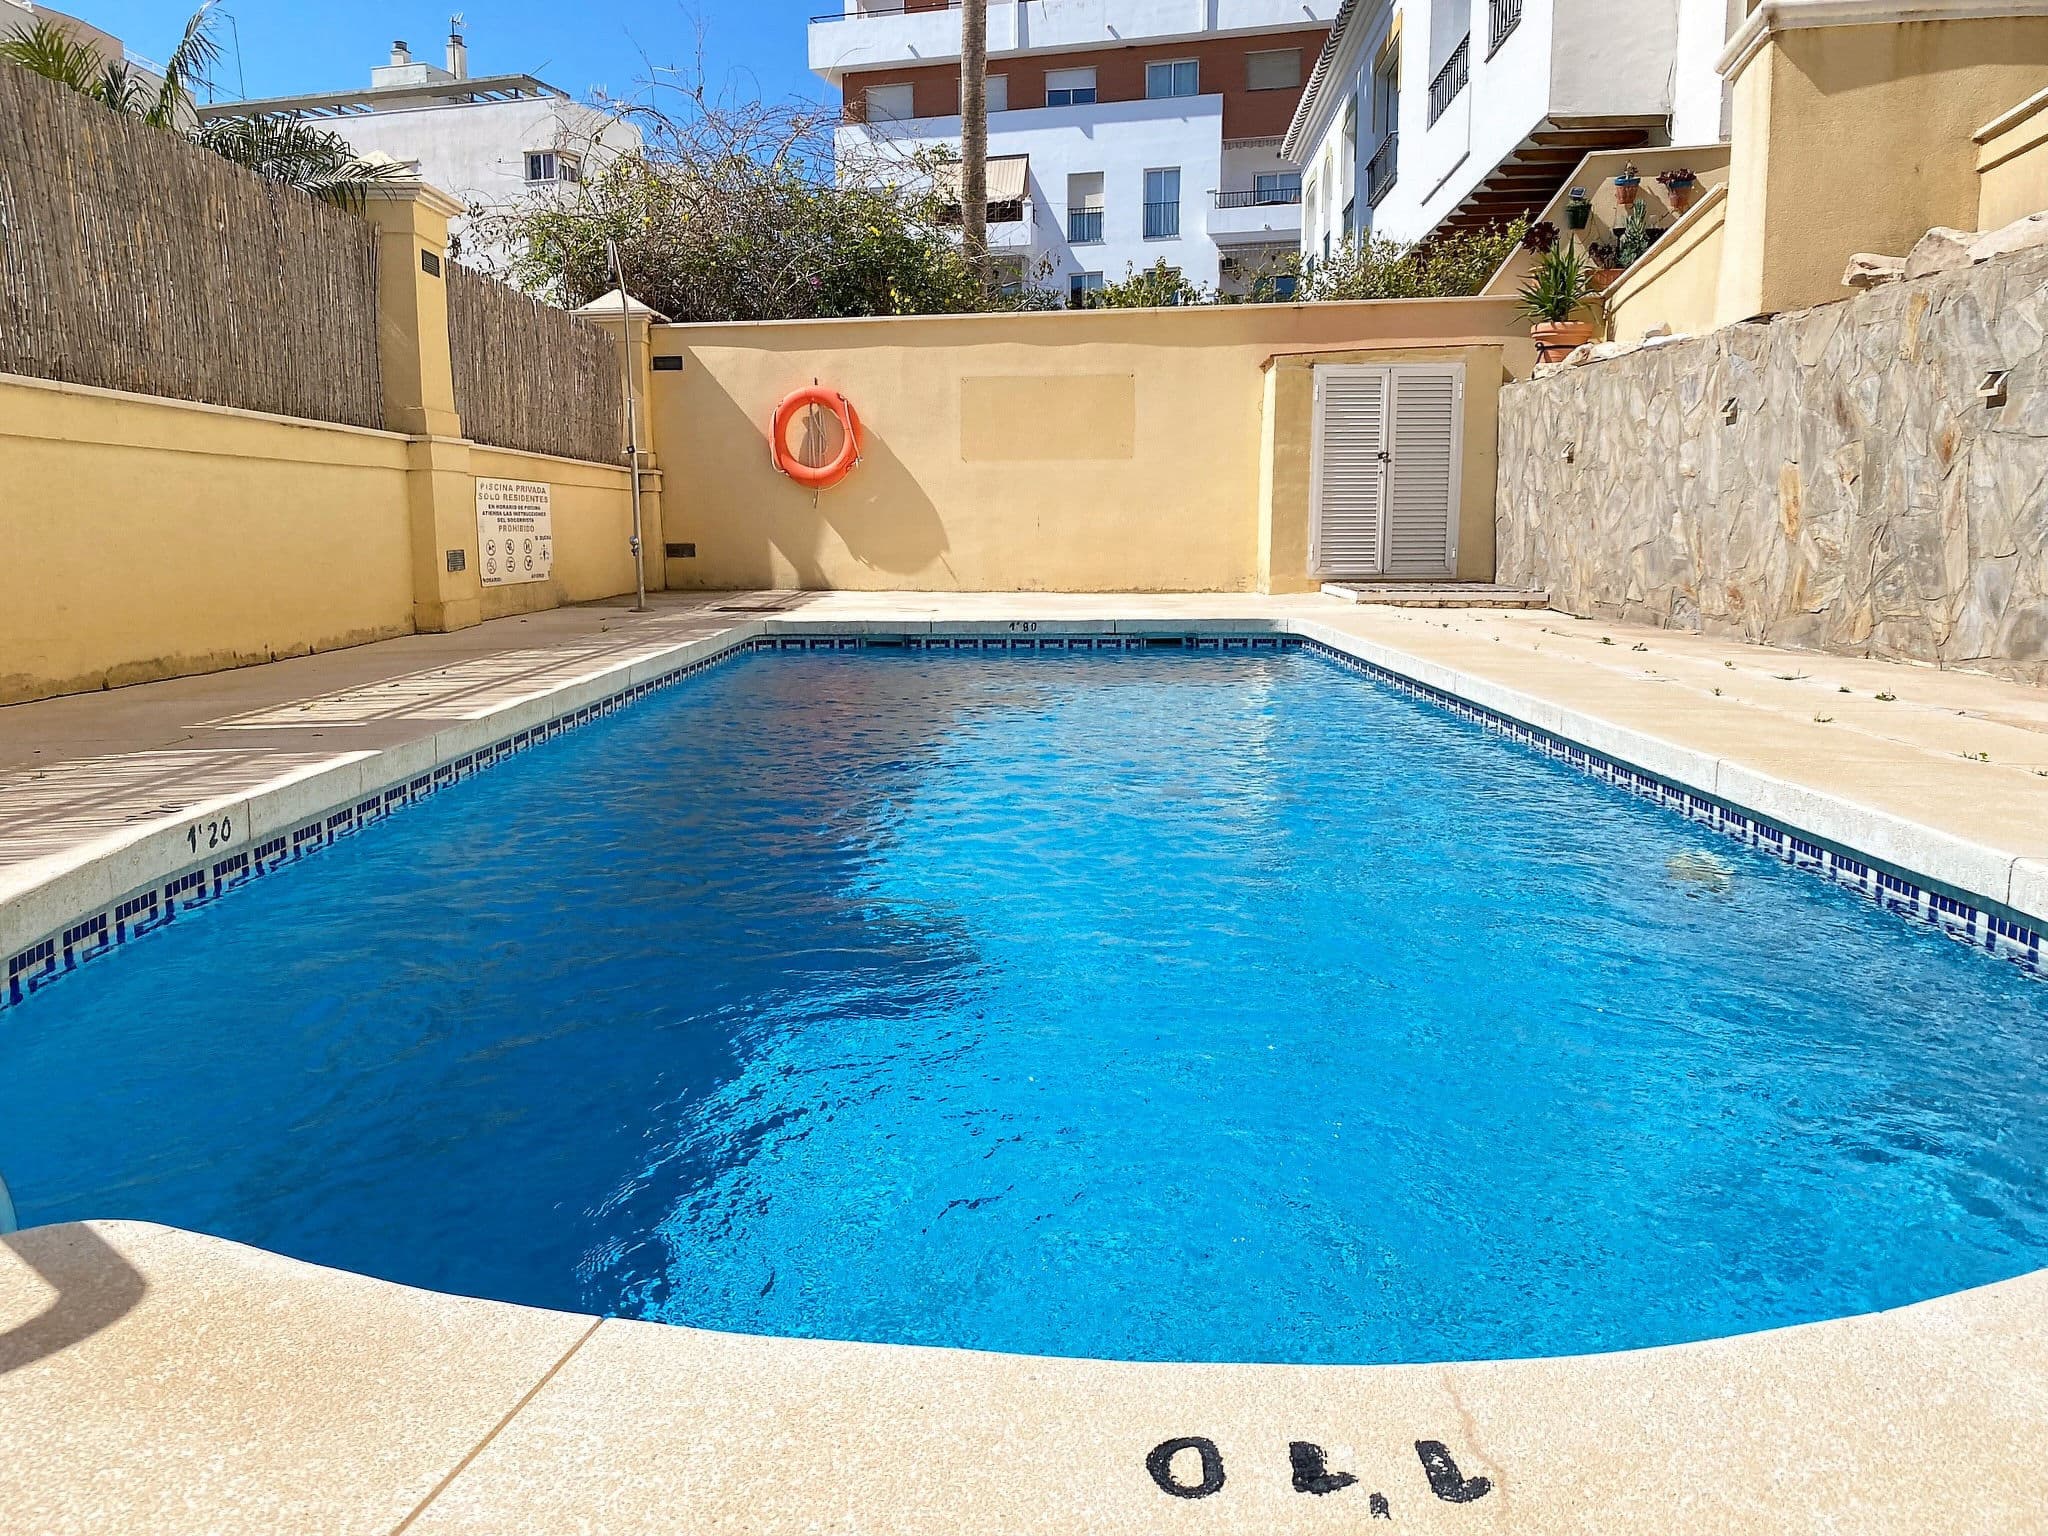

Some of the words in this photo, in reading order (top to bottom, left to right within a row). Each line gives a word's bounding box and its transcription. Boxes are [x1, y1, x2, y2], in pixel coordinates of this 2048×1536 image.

[480, 483, 513, 491] PISCINA
[516, 485, 546, 494] PRIVADA
[503, 494, 548, 503] RESIDENTES
[187, 816, 231, 853] 1'20
